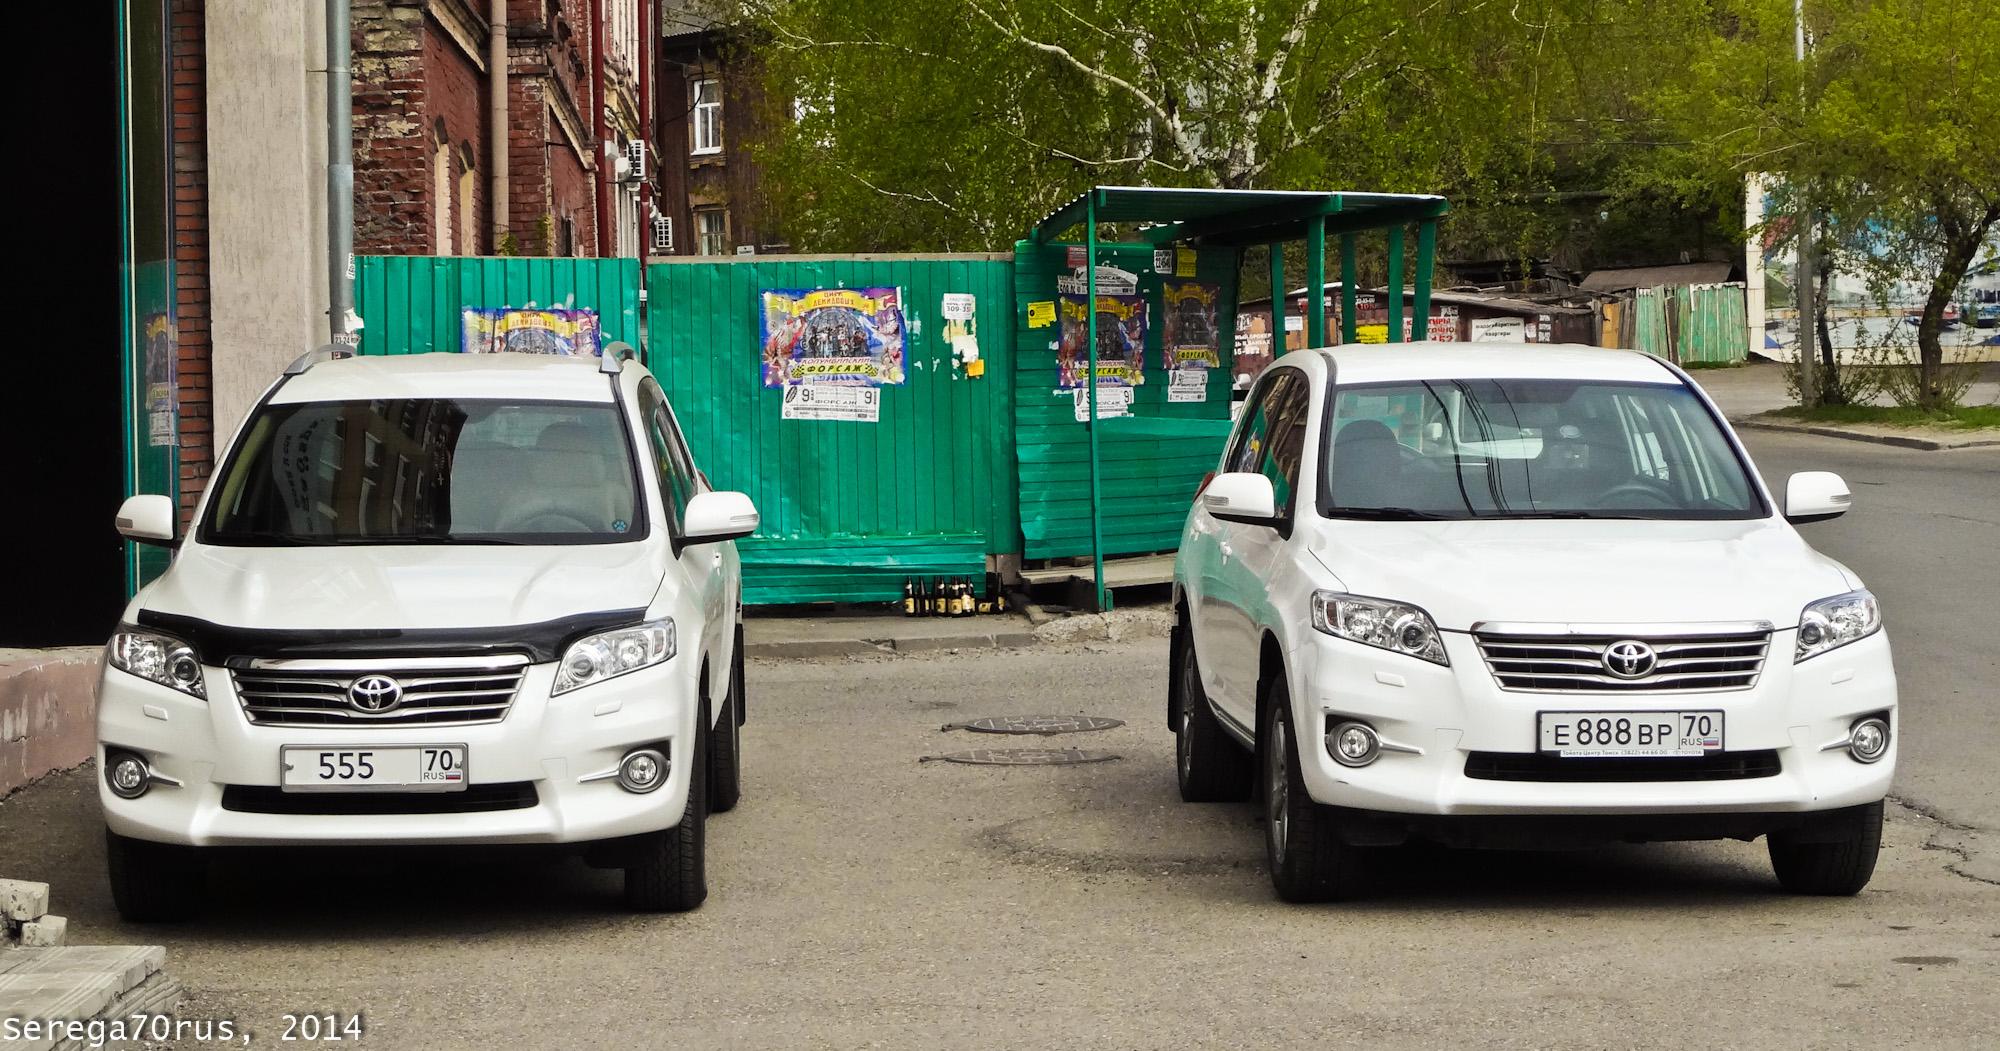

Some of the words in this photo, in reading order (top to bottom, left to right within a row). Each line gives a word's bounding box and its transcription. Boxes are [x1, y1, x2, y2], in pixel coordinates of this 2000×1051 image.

[813, 298, 854, 307] ДЕМИДОВЫХ
[807, 365, 862, 373] ФОРСАЖ
[801, 388, 810, 402] 9
[864, 391, 873, 405] 9
[1123, 390, 1130, 403] 9
[1683, 715, 1711, 737] 70
[1681, 738, 1702, 746] RUS
[319, 752, 374, 780] 555
[425, 750, 453, 771] 70
[423, 772, 445, 780] RUS
